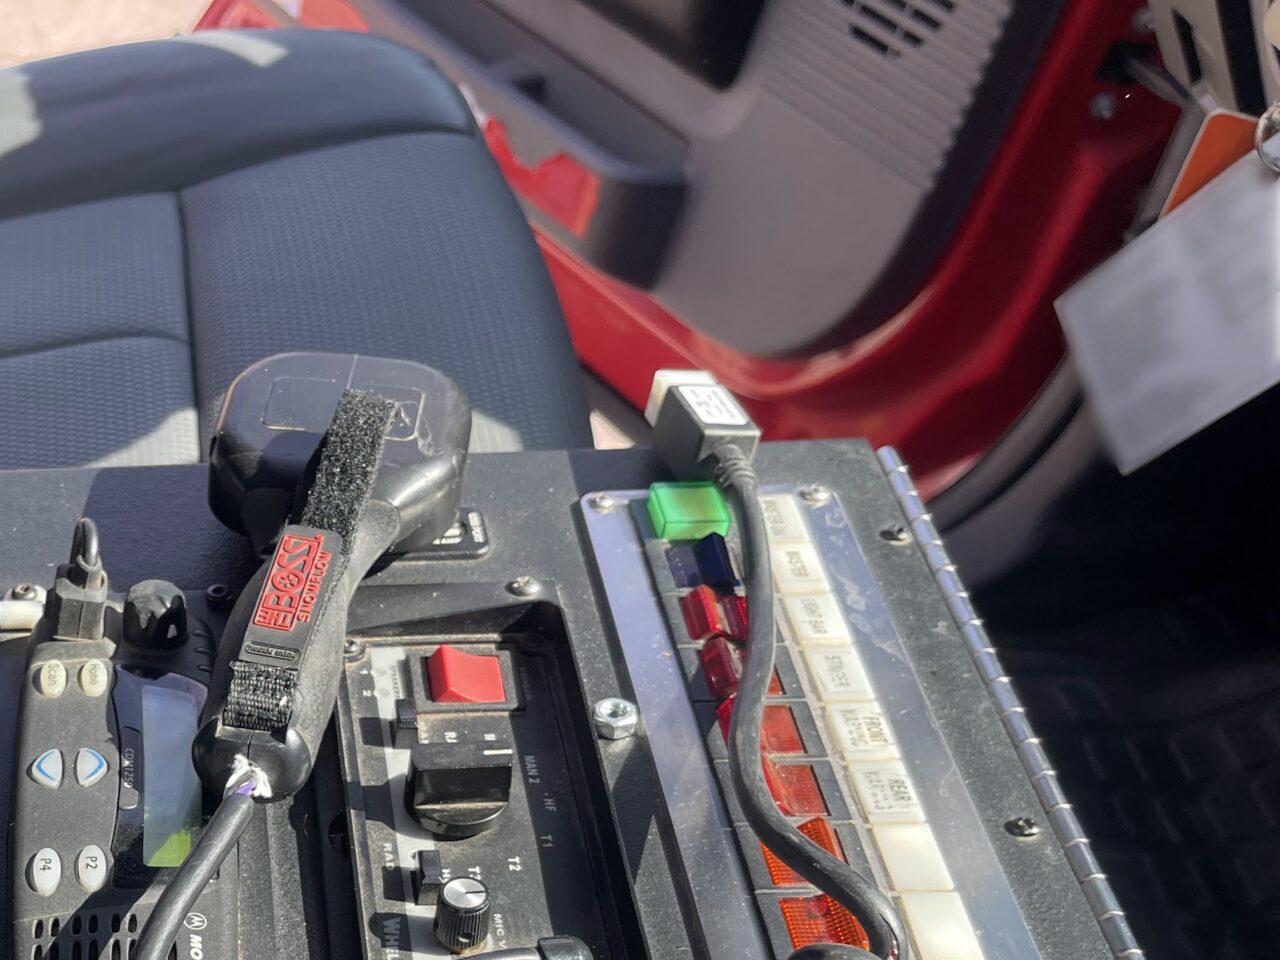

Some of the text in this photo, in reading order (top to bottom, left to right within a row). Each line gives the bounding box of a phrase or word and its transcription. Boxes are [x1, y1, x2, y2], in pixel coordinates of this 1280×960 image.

[261, 536, 319, 613] BOSS
[256, 608, 292, 629] THE
[47, 662, 60, 686] Scan
[89, 663, 101, 686] Home
[861, 713, 889, 745] FRONT
[524, 754, 540, 785] MAN 2
[544, 798, 556, 812] HF
[887, 777, 911, 810] REAR
[540, 834, 554, 848] T1
[40, 858, 51, 872] P4
[86, 857, 98, 870] P2
[507, 856, 521, 872] T2
[493, 913, 505, 938] MIC
